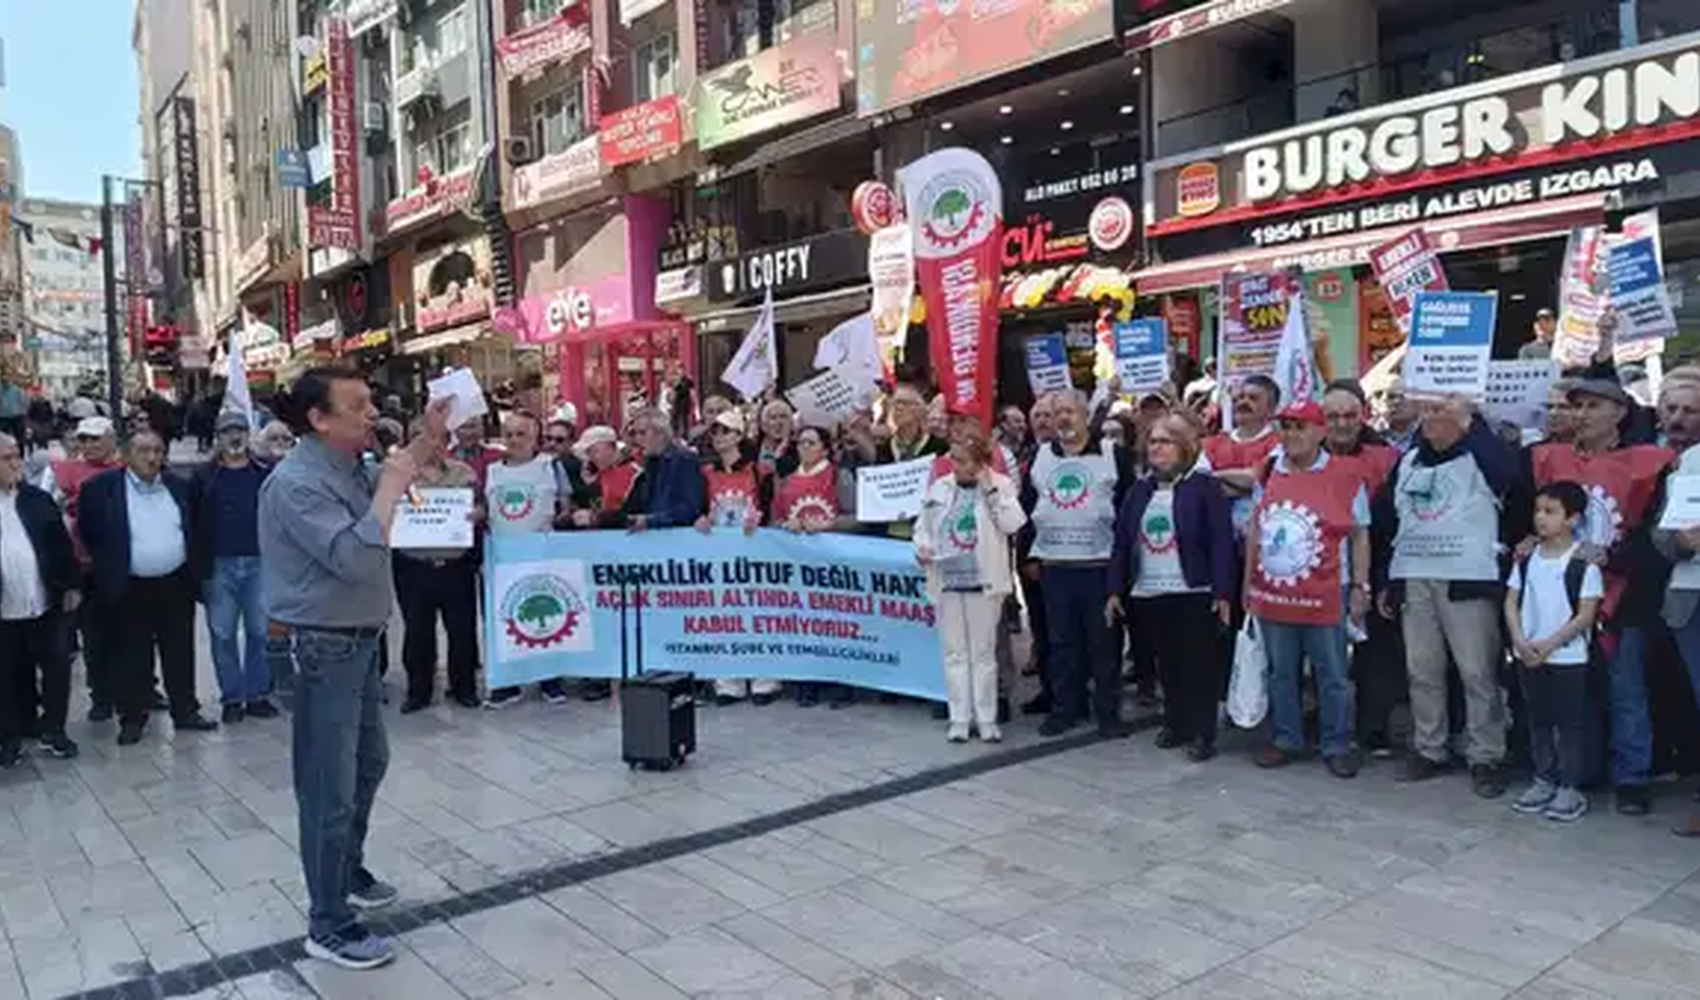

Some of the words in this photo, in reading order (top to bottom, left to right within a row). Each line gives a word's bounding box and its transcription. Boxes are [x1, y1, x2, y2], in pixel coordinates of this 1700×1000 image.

[1243, 96, 1515, 201] BURGER
[1541, 51, 1700, 145] KIN
[1251, 212, 1355, 248] 1954'TEN
[1361, 202, 1420, 229] BERİ
[1424, 182, 1533, 218] ALEVDE
[1540, 158, 1659, 198] IZGARA
[751, 244, 810, 290] COFFY
[592, 559, 714, 585] EMEKLİLİK
[722, 556, 795, 585] LÜTUF
[801, 563, 864, 592] DEĞİL
[656, 589, 715, 608] SINIRI
[722, 588, 802, 609] ALTINDA
[808, 590, 874, 615] EMEKLİ
[684, 614, 746, 634] KABUL
